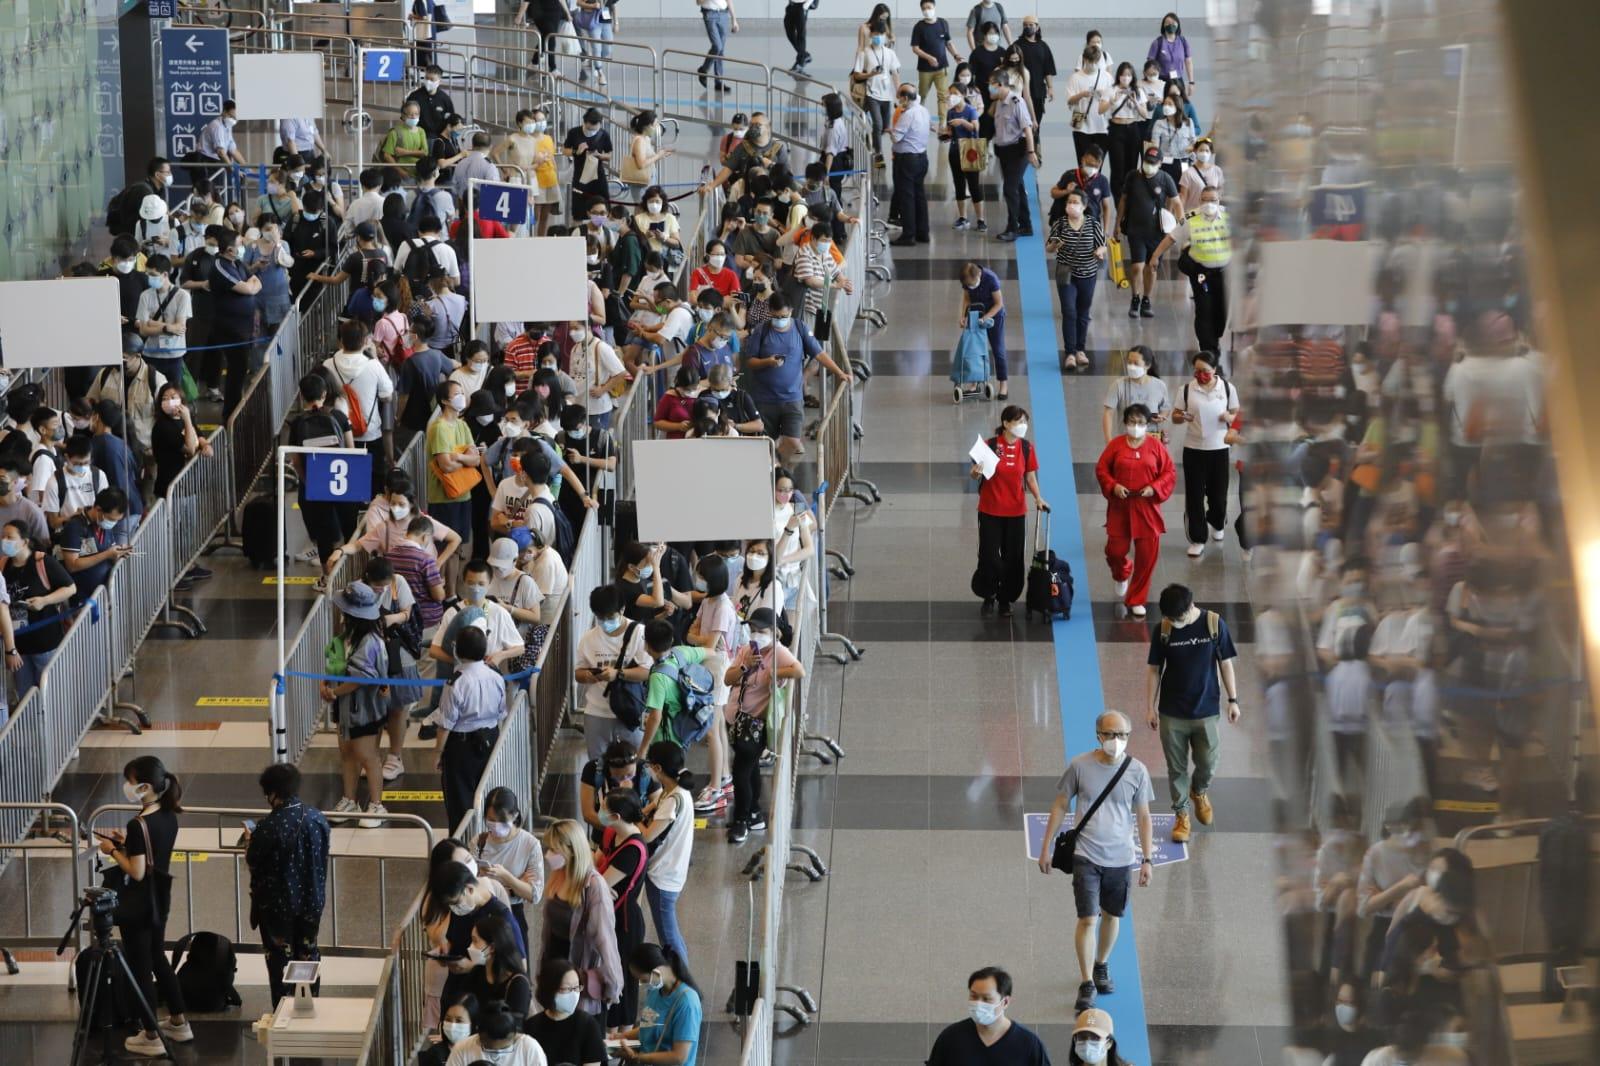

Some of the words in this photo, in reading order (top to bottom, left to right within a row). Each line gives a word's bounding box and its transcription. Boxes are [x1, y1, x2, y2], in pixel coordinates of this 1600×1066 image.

[378, 55, 390, 78] 2
[495, 191, 510, 219] 4
[329, 459, 349, 496] 3
